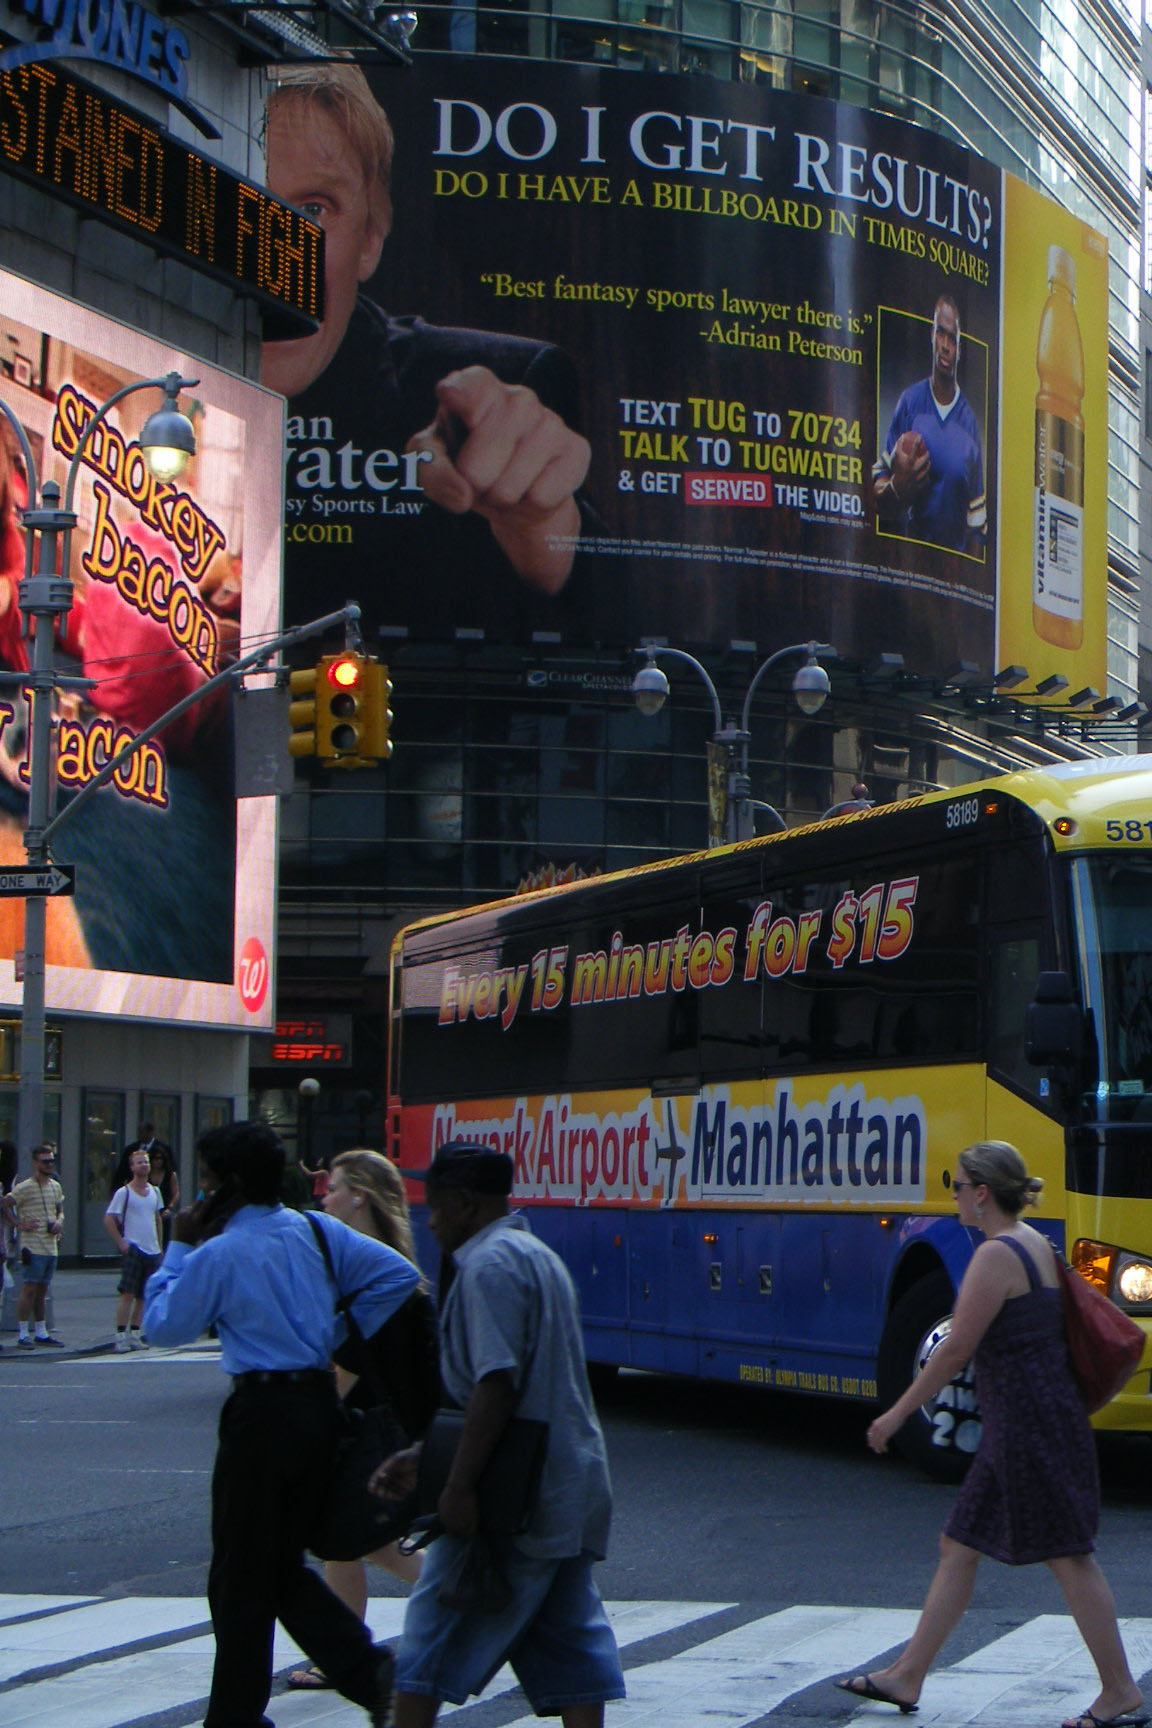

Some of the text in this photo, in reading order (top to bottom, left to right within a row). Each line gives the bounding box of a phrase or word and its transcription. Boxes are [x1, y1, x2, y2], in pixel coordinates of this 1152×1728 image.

[432, 97, 993, 250] DO I GET RESULTS?
[236, 182, 322, 316] FIGHT
[432, 169, 990, 286] DO I HAVE A BILLBOARD IN TIMES SQUARE?
[553, 275, 639, 310] fantasy
[646, 288, 715, 312] sports
[721, 288, 791, 324] lawyer
[796, 300, 843, 331] there
[787, 331, 864, 366] Peterson
[618, 396, 863, 450] TEXT TUG TO 70734
[54, 385, 226, 583] smokey
[618, 430, 864, 485] TALK TO TUGWATER
[311, 494, 376, 517] Sports
[381, 496, 425, 516] Law
[617, 470, 867, 518] & GET SERVED THE VIDEO.
[82, 481, 218, 678] bacon
[945, 800, 979, 829] 58189
[0, 874, 63, 889] ONE WAY
[439, 876, 920, 1031] Every 15 minutes for $15
[271, 1044, 343, 1061] ESPN
[536, 1104, 652, 1207] Airport
[691, 1093, 921, 1188] Manhattan
